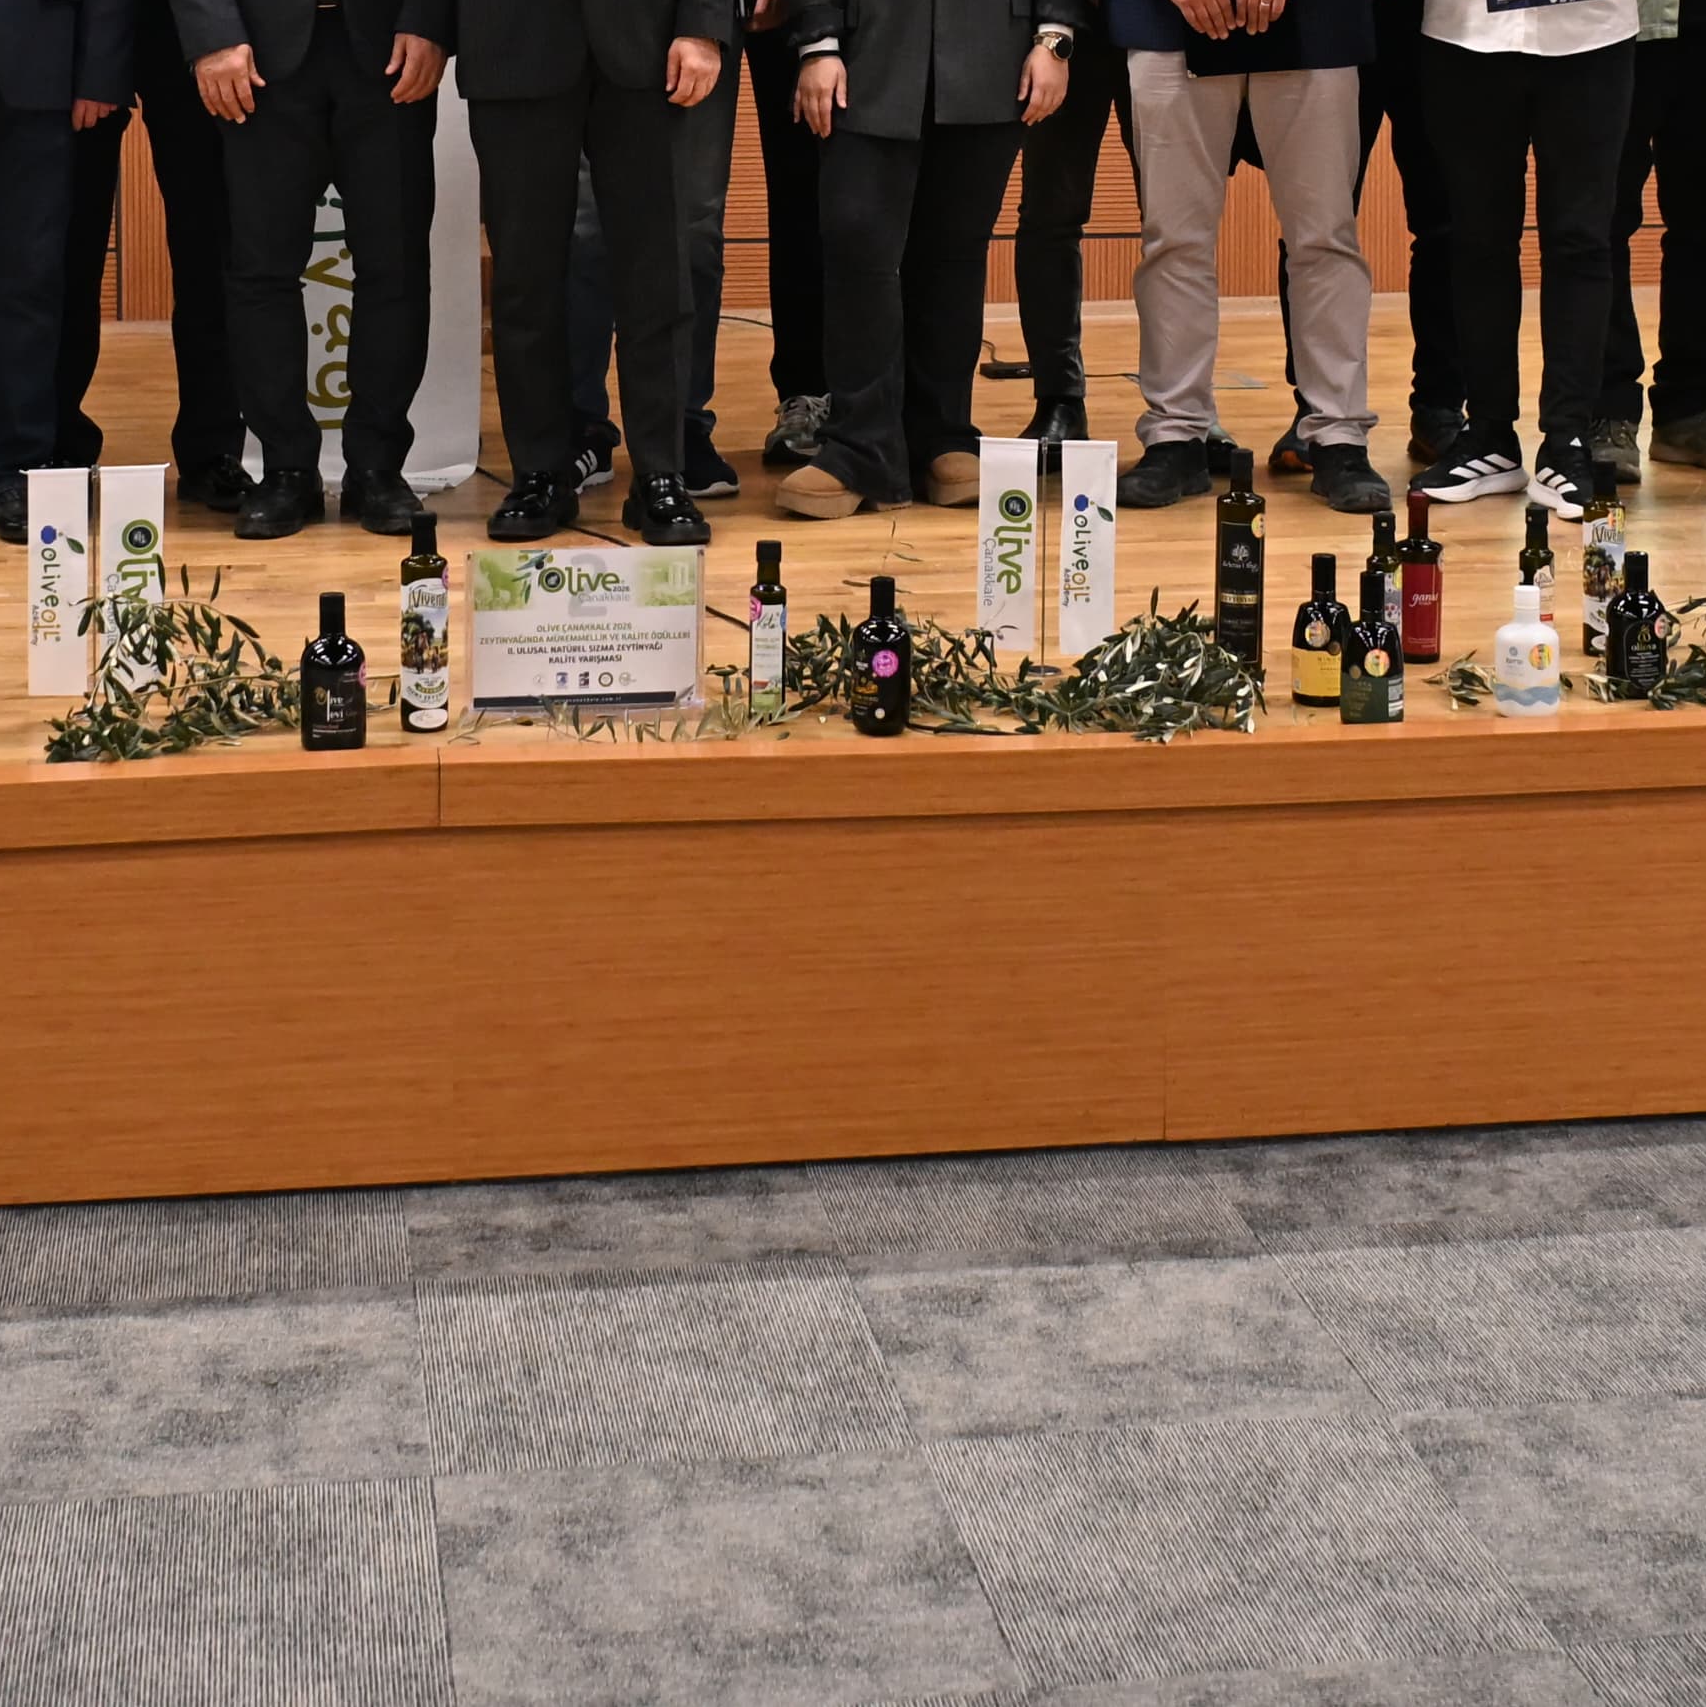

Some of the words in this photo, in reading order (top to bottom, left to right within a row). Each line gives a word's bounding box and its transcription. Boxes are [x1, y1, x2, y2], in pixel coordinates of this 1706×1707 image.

[996, 489, 1033, 595] Olive
[539, 566, 621, 596] Olive
[984, 537, 996, 607] Çanakkale
[612, 622, 632, 631] 2026
[516, 646, 549, 655] ULUSAL
[589, 644, 615, 653] SIZMA
[548, 654, 576, 664] KALİTE
